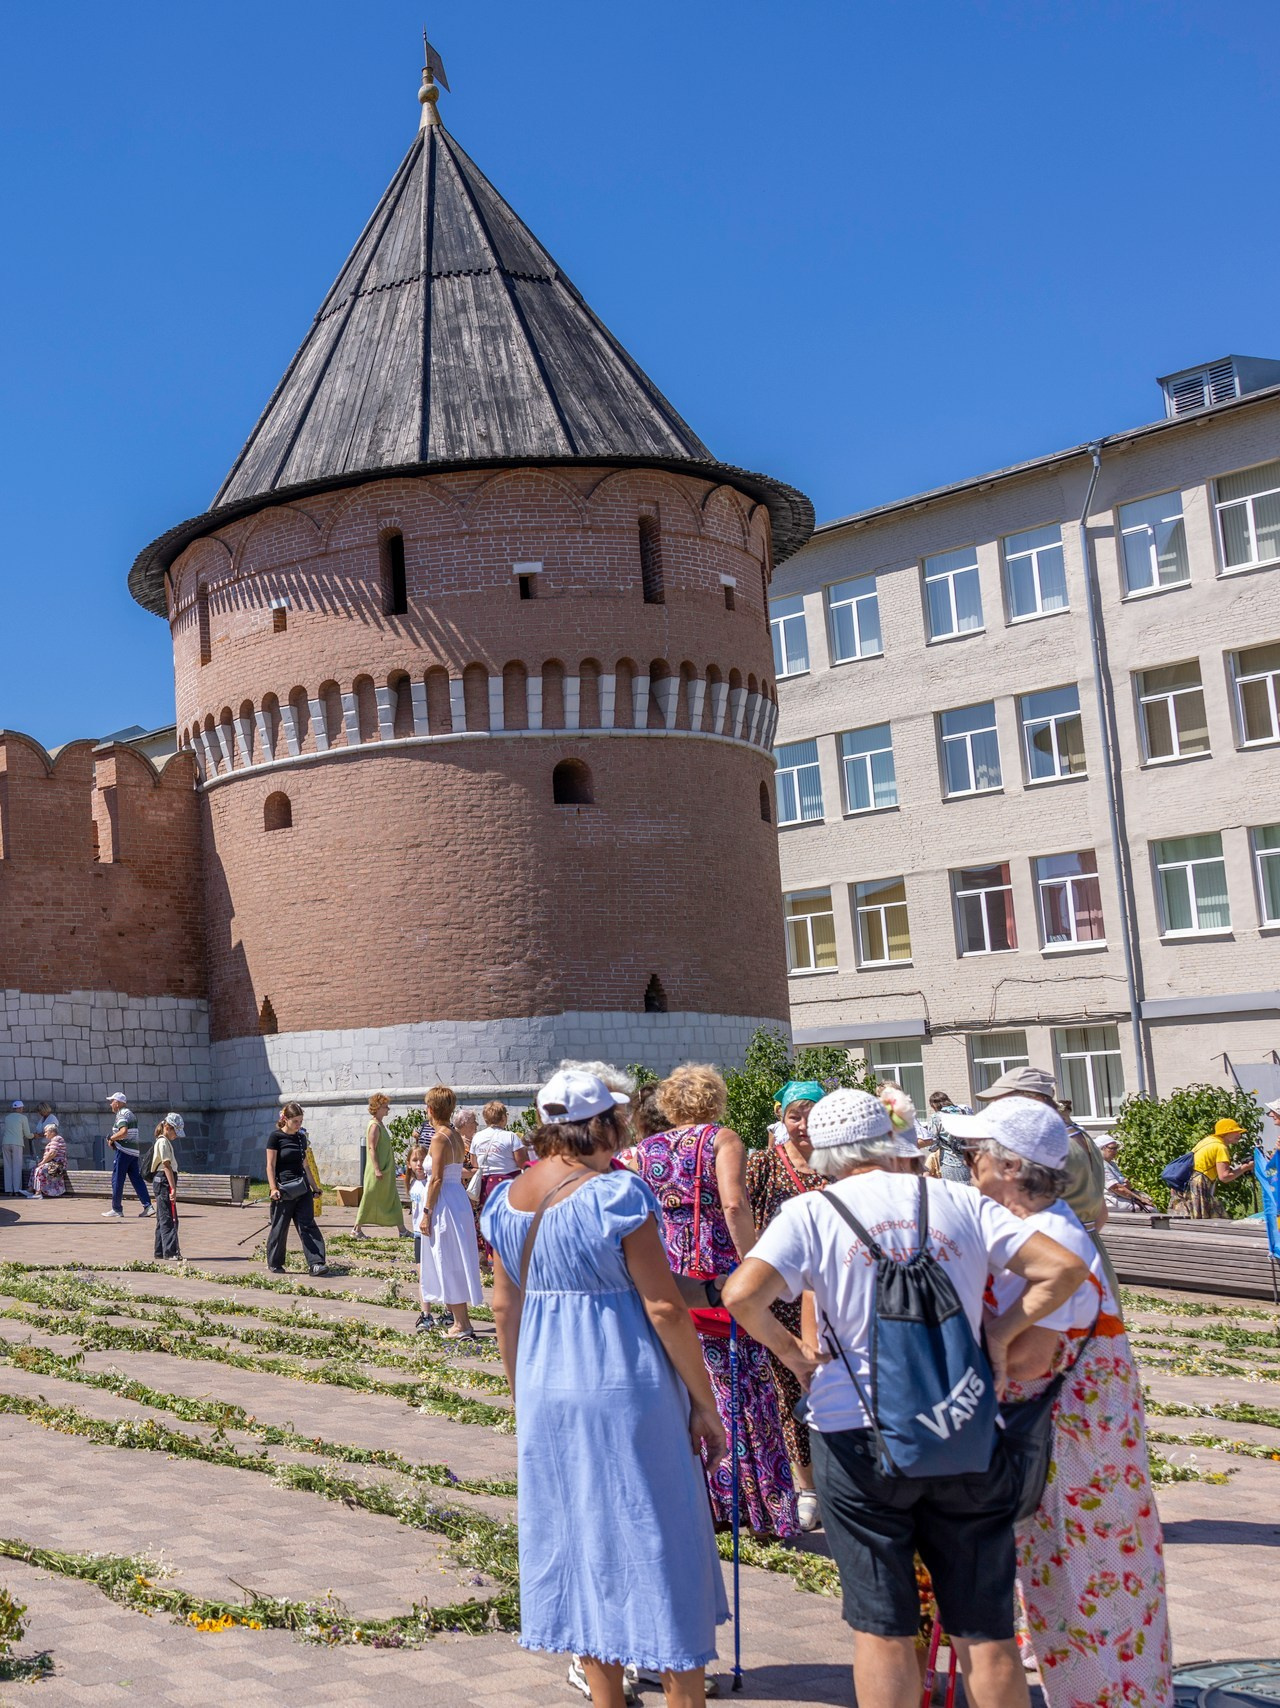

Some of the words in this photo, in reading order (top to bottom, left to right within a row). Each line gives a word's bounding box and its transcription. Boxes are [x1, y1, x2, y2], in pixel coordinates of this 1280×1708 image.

[868, 1219, 918, 1237] ЕВЕРНОЙ
[927, 1225, 962, 1258] ОДЬБЫ
[915, 1366, 986, 1440] VANS
